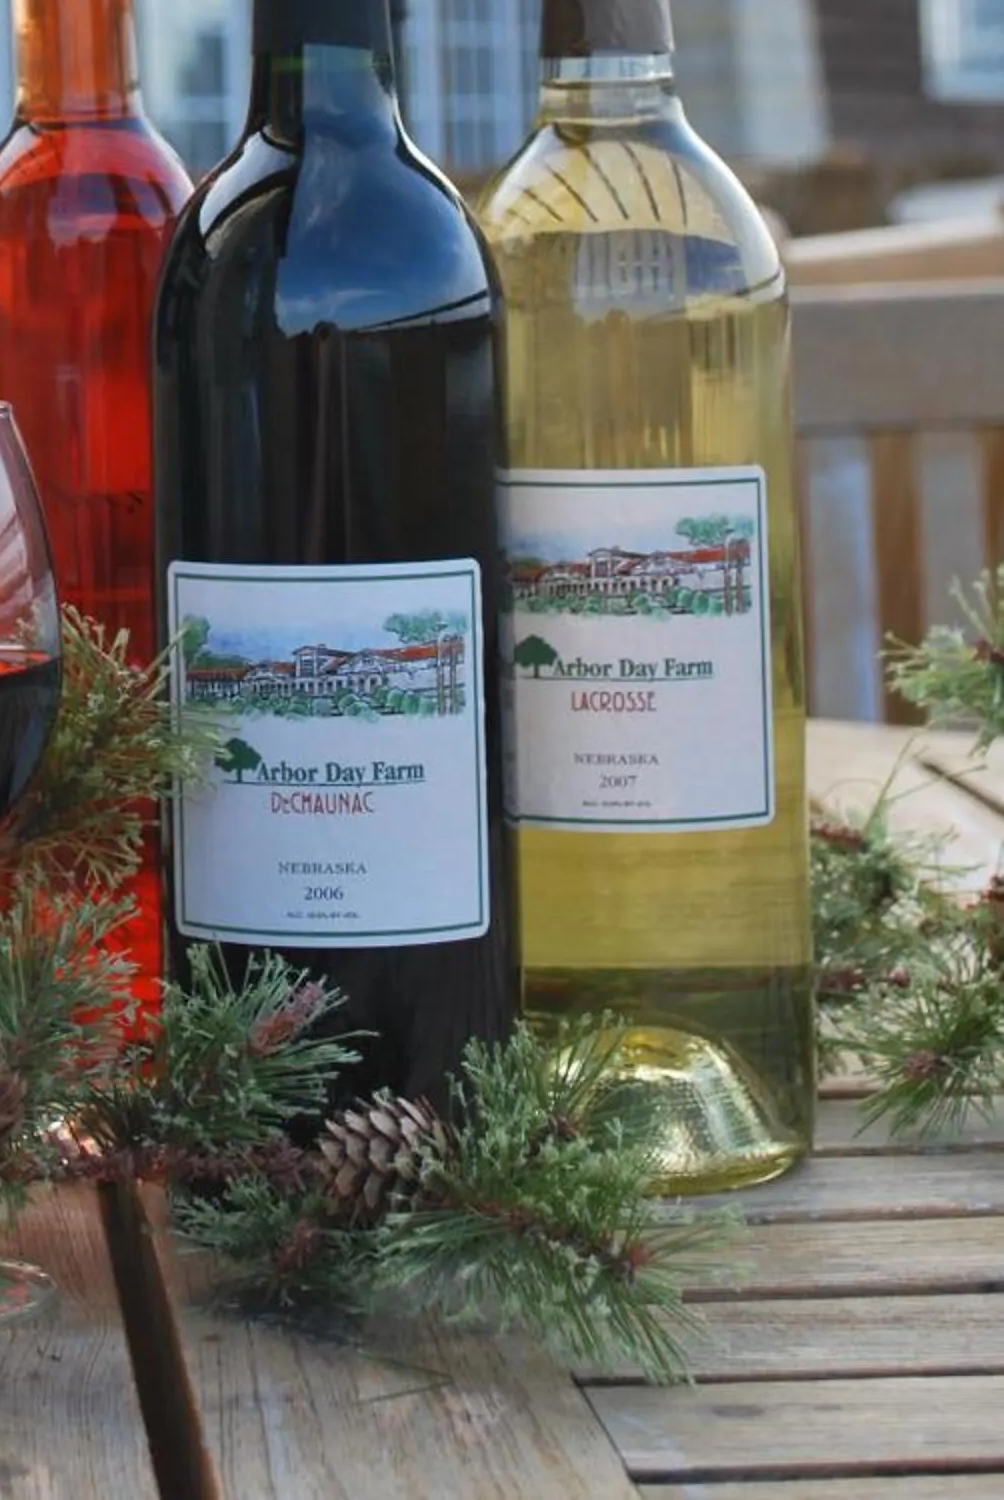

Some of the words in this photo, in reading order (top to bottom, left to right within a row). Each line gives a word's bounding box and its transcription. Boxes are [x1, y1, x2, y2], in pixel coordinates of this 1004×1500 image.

[552, 658, 612, 678] Arbor
[619, 659, 658, 680] Day
[664, 657, 714, 677] Farm
[570, 691, 657, 713] LACROSSE
[574, 752, 660, 766] NEBRASKA
[256, 760, 319, 783] Arbor
[326, 761, 366, 788] Day
[372, 760, 426, 781] Farm
[598, 775, 638, 789] 2007
[277, 861, 367, 876] NEBRASKA
[303, 886, 345, 901] 2006
